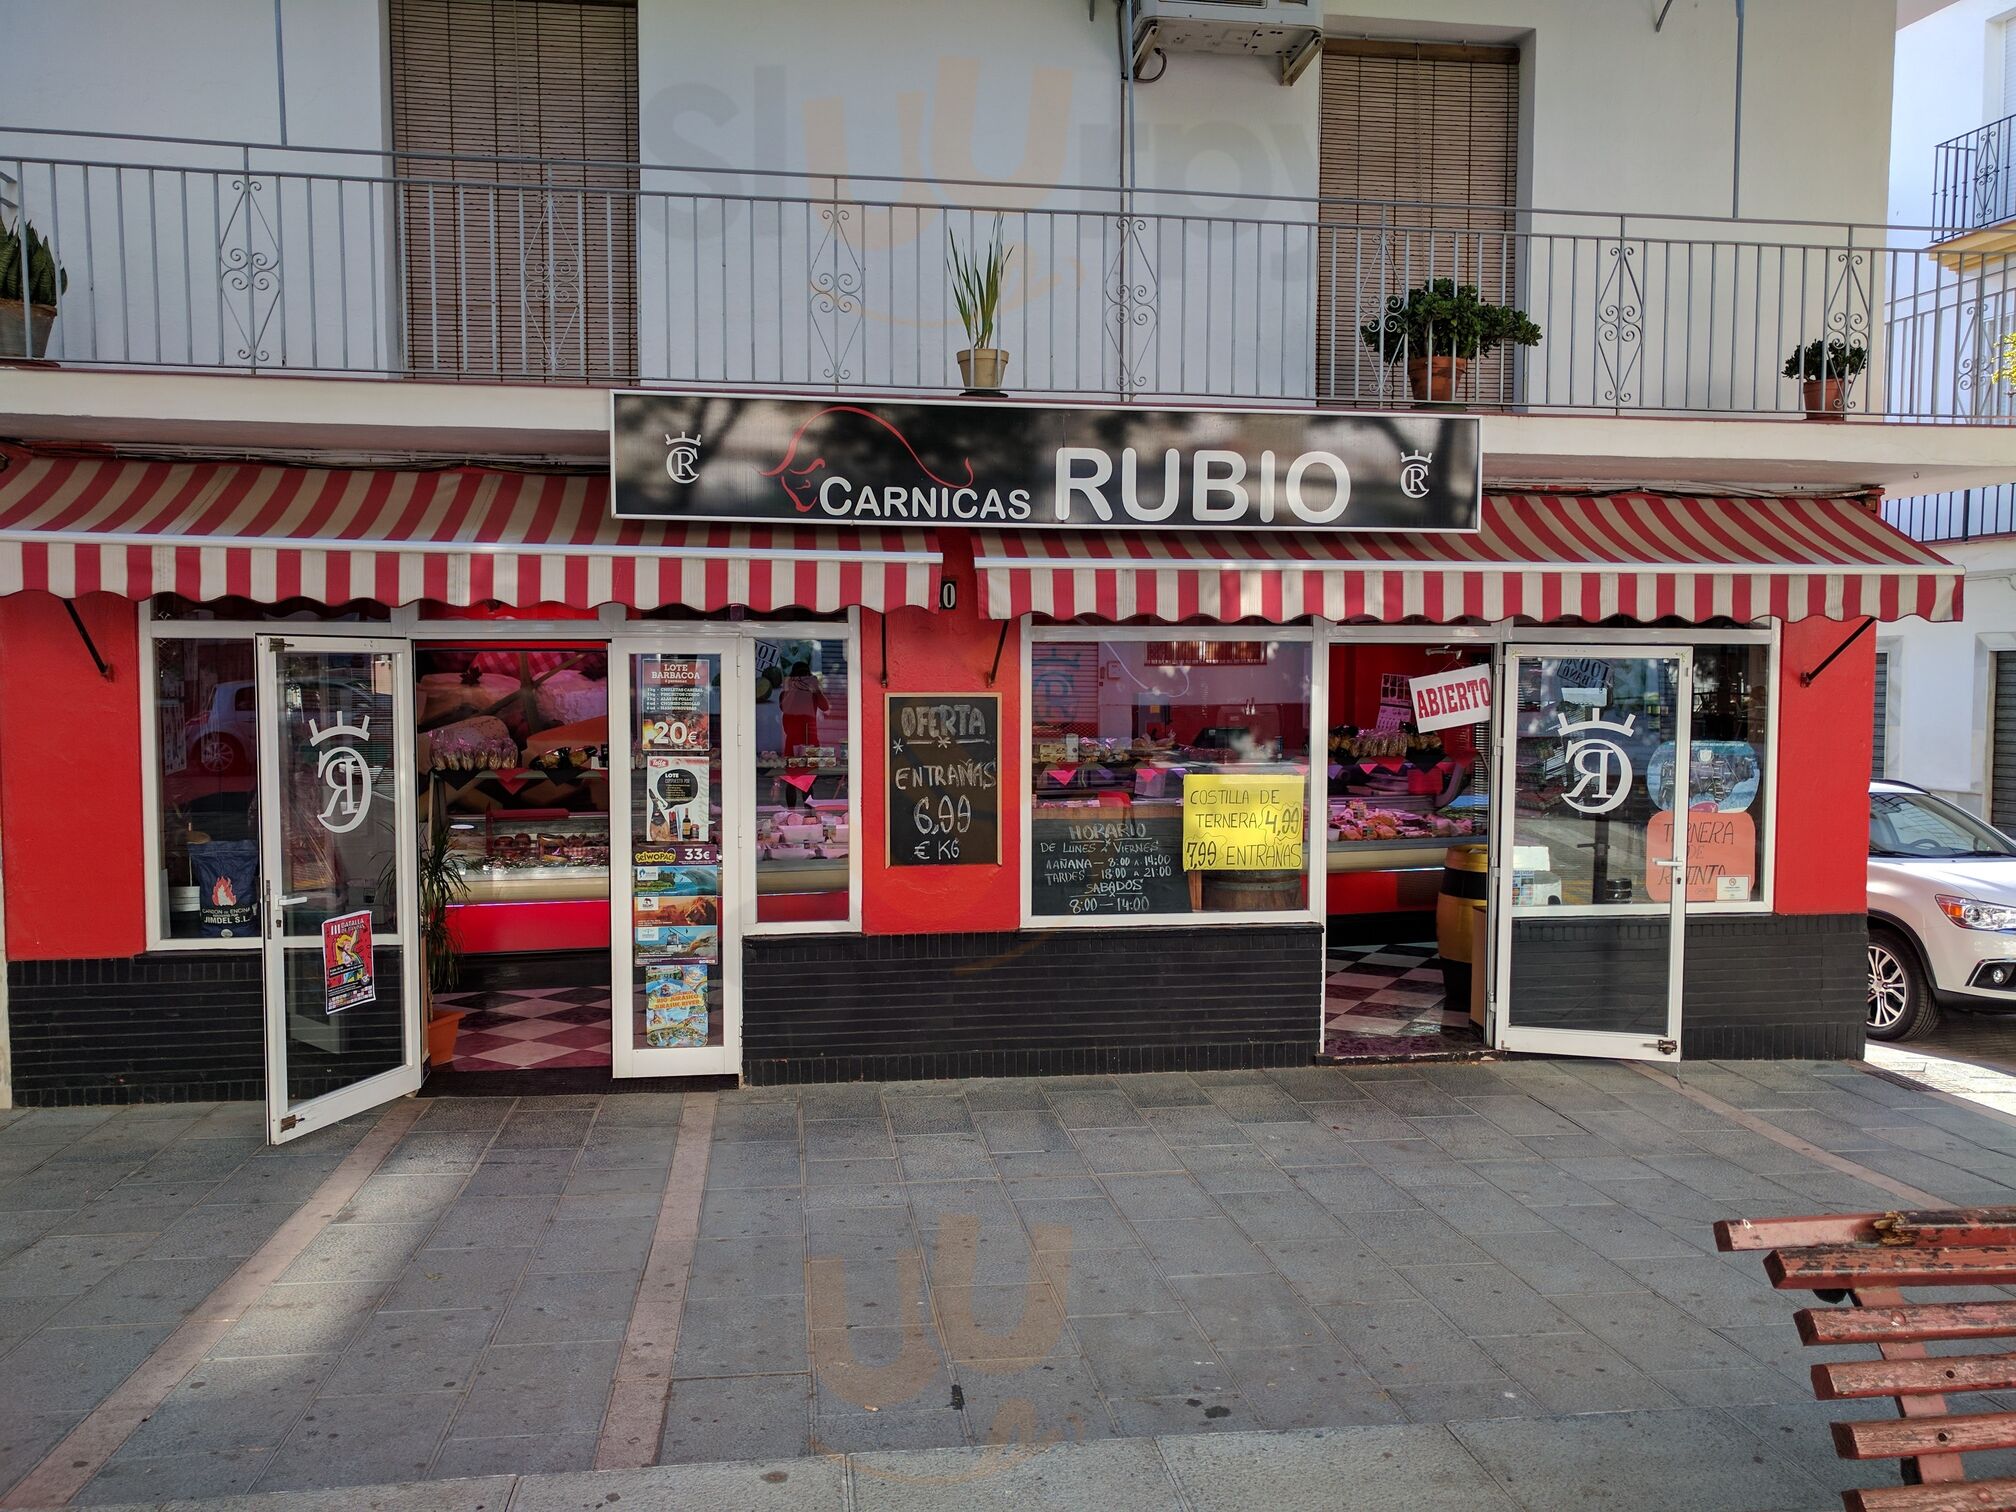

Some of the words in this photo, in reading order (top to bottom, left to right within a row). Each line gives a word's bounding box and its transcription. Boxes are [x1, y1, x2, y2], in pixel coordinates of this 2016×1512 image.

[819, 476, 1031, 521] CARNICAS
[1055, 447, 1351, 524] RUBIO
[651, 671, 701, 680] BARBACOA
[664, 664, 688, 672] LOTE
[1416, 677, 1491, 719] ABIERTO
[901, 704, 986, 737] OFERTA
[895, 758, 997, 790] ENTRAÑAS
[1190, 789, 1250, 805] COSTILLA
[1259, 789, 1280, 805] DE
[914, 794, 971, 834] 6,99
[1195, 812, 1258, 829] TERNERA
[1265, 807, 1300, 836] 4,99
[1068, 823, 1147, 840] HORARIO
[1663, 821, 1735, 845] TNERA
[684, 848, 711, 861] 33€
[914, 841, 930, 859] €
[938, 839, 960, 860] KG
[1040, 842, 1056, 853] DE
[1063, 842, 1096, 854] LUNES
[1112, 840, 1159, 854] VIERNES
[1186, 841, 1217, 869] 7,99
[1226, 842, 1301, 868] ENTRAÑAS
[1107, 857, 1130, 866] 8:00
[1144, 854, 1171, 866] 14:00
[1044, 869, 1085, 886] TARDES
[1101, 867, 1127, 880] 18:00
[1143, 865, 1172, 877] 21:00
[1658, 863, 1727, 887] RTINT
[1084, 878, 1143, 894] SABADOS
[1069, 896, 1098, 914] 8:00
[1117, 895, 1150, 912] 14:00
[204, 916, 233, 924] JIMDEL
